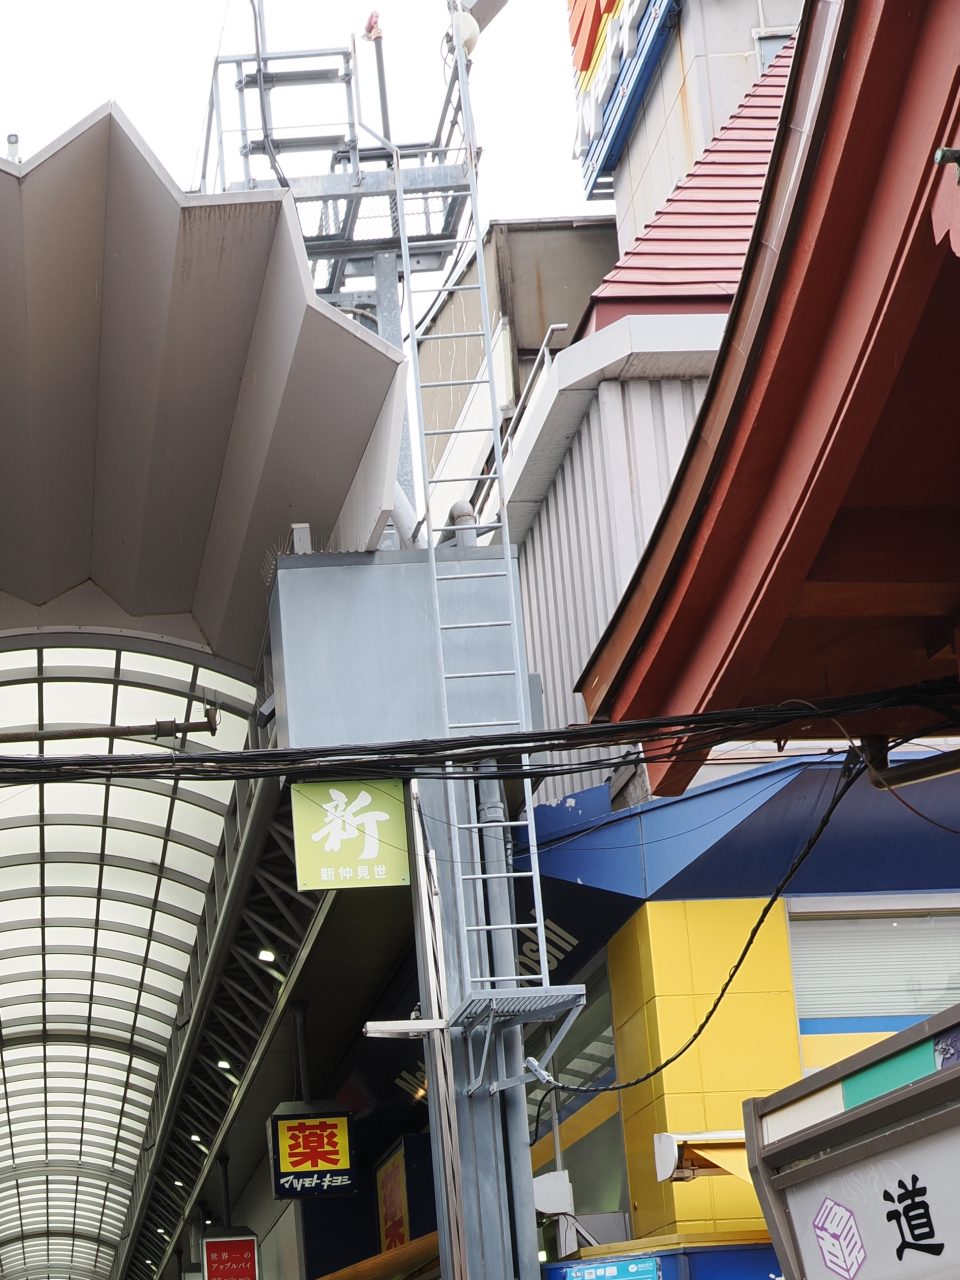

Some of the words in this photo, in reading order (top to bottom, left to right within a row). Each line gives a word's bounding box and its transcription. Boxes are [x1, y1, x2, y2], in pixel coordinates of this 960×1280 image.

[312, 788, 390, 860] 新
[320, 864, 387, 881] 新仲見世
[287, 1121, 341, 1168] 薬
[280, 1173, 352, 1191] マツモトキヨシ
[882, 1174, 945, 1262] 道
